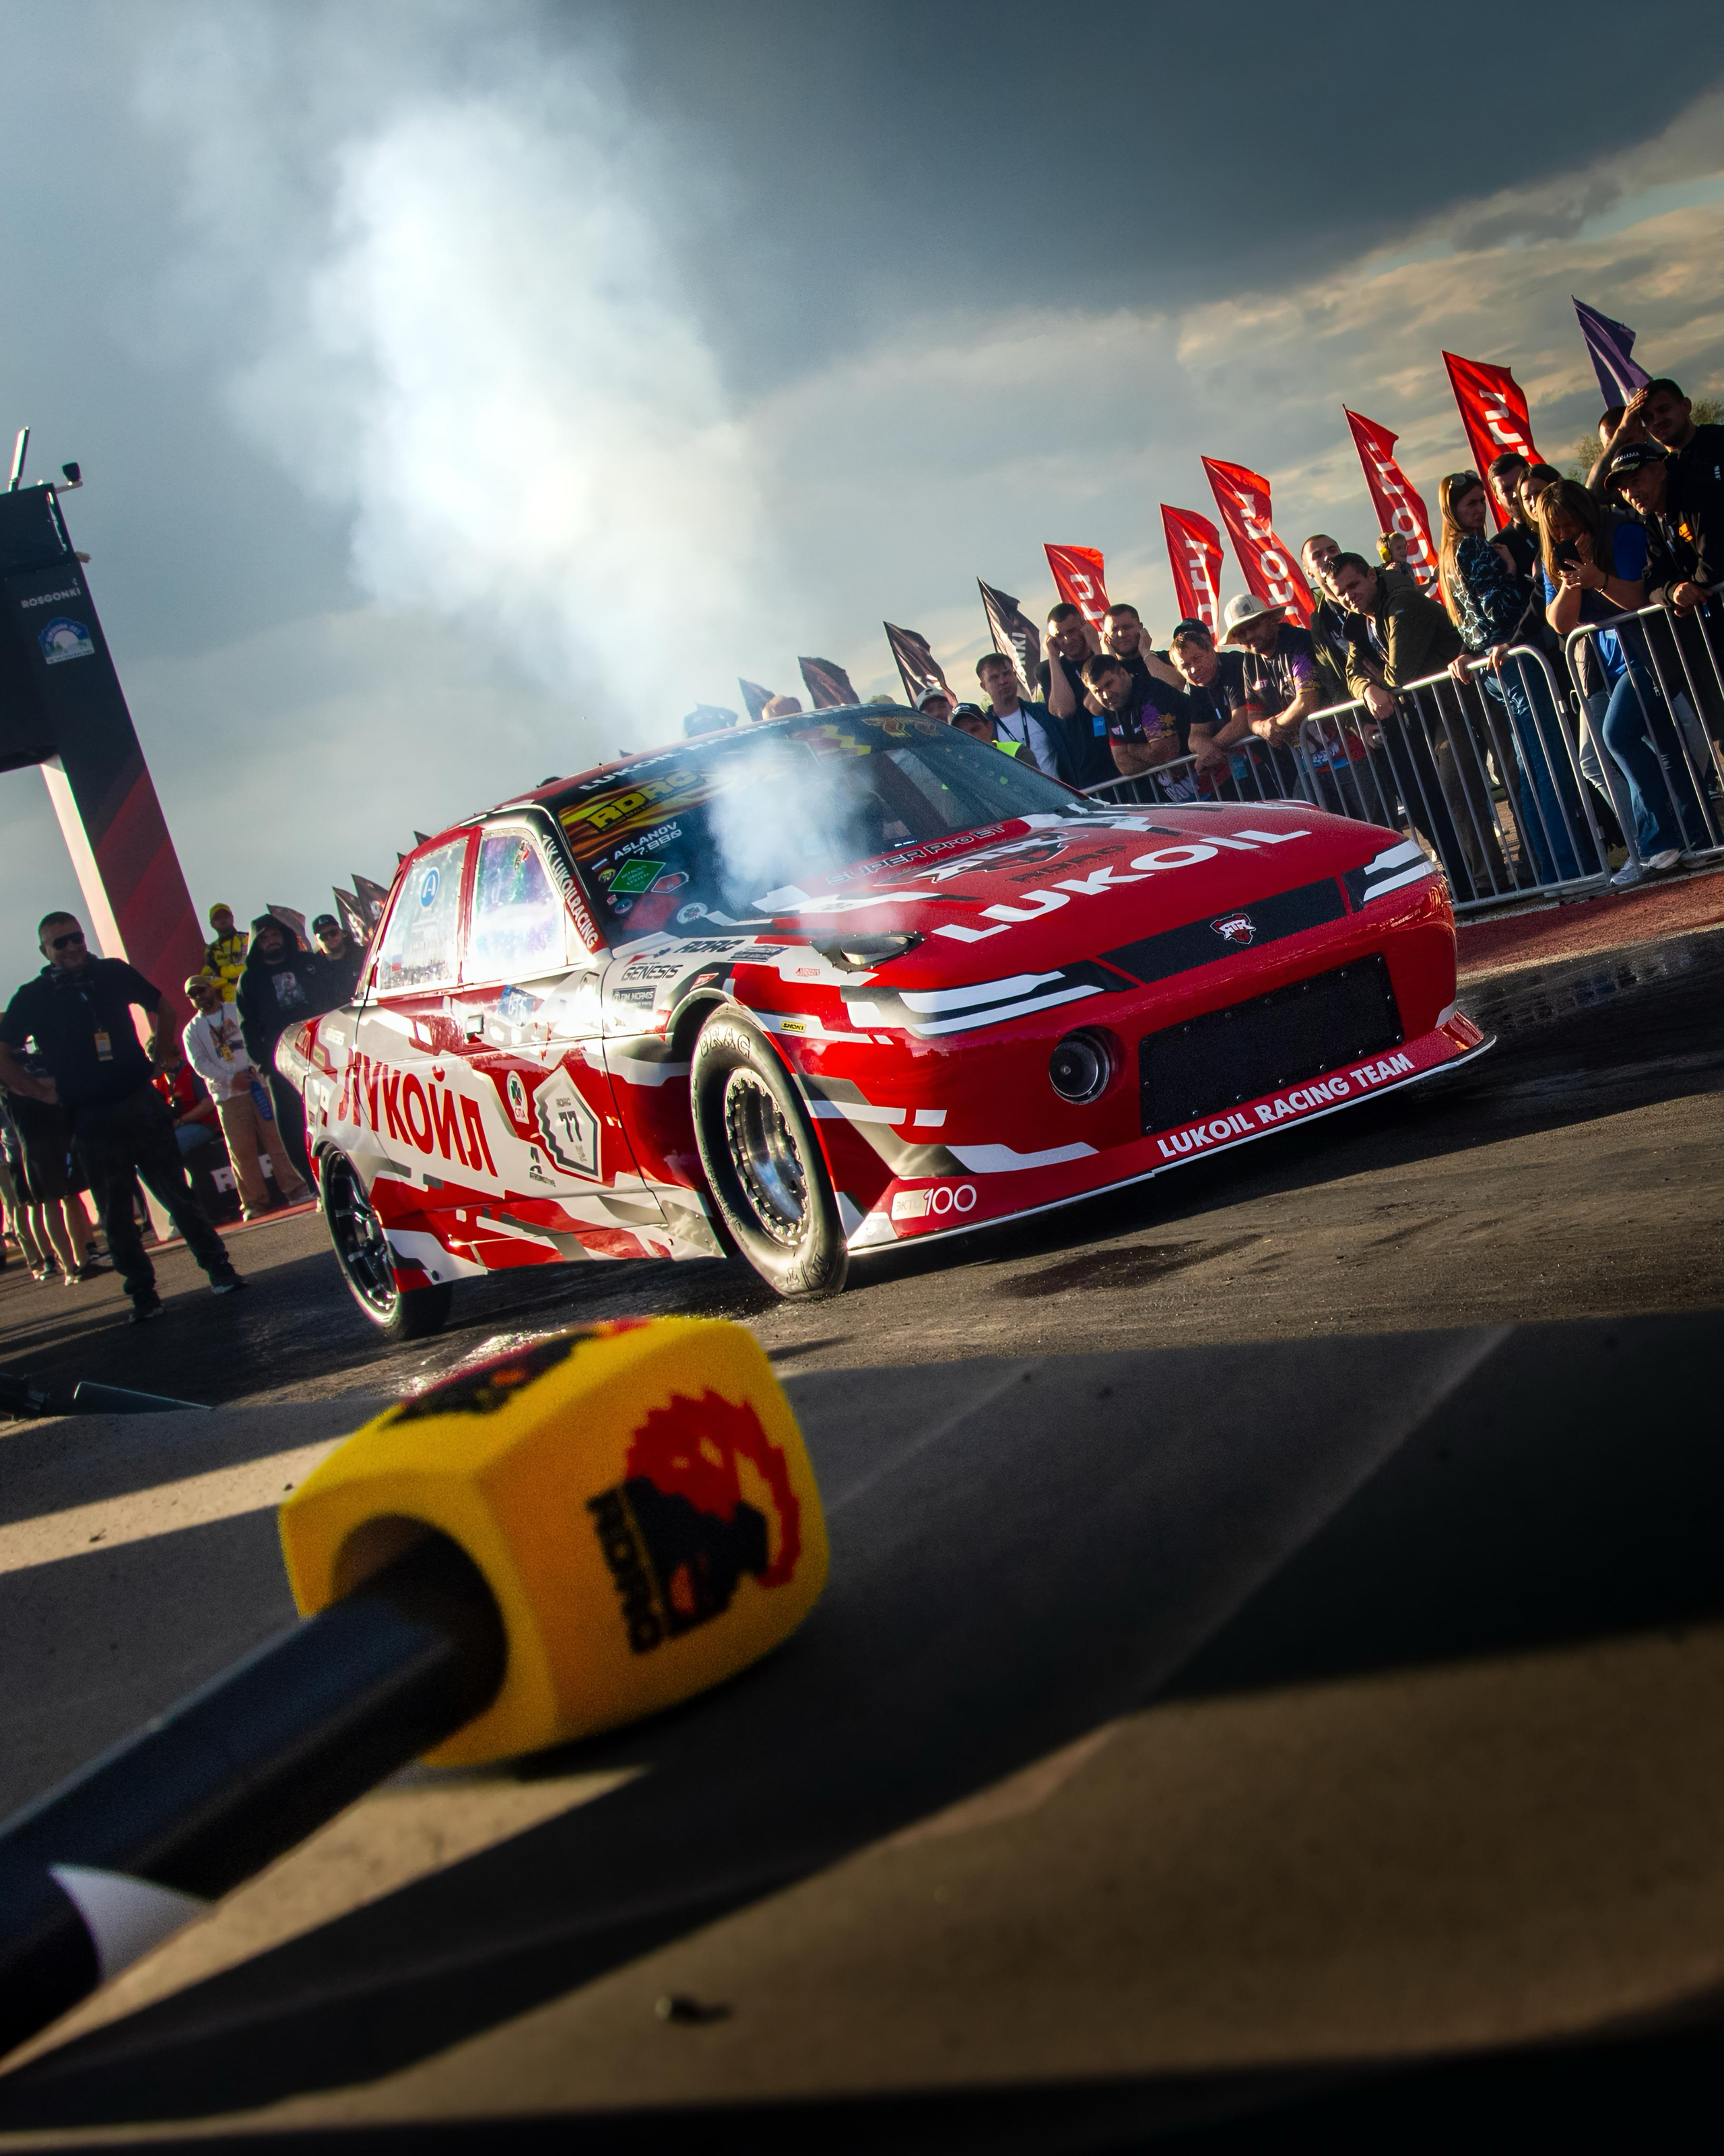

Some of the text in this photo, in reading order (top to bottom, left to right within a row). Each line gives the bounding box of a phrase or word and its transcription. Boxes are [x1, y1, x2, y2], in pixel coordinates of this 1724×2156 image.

[21, 587, 81, 608] ROSGONKI
[578, 752, 681, 791] LUKOIL
[587, 771, 699, 830] RDRC
[614, 821, 677, 860] ASLANOV
[826, 850, 927, 885] SUPER
[923, 835, 974, 855] Pro
[931, 830, 1311, 942] LUKOIL
[622, 965, 684, 981] GENESIS
[699, 1026, 750, 1059] DRAG
[338, 1047, 498, 1178] ЛУКОЙЛ
[1158, 1053, 1414, 1157] LUKOIL RACING TEAM
[558, 1110, 583, 1142] 77
[923, 1184, 977, 1216] 100
